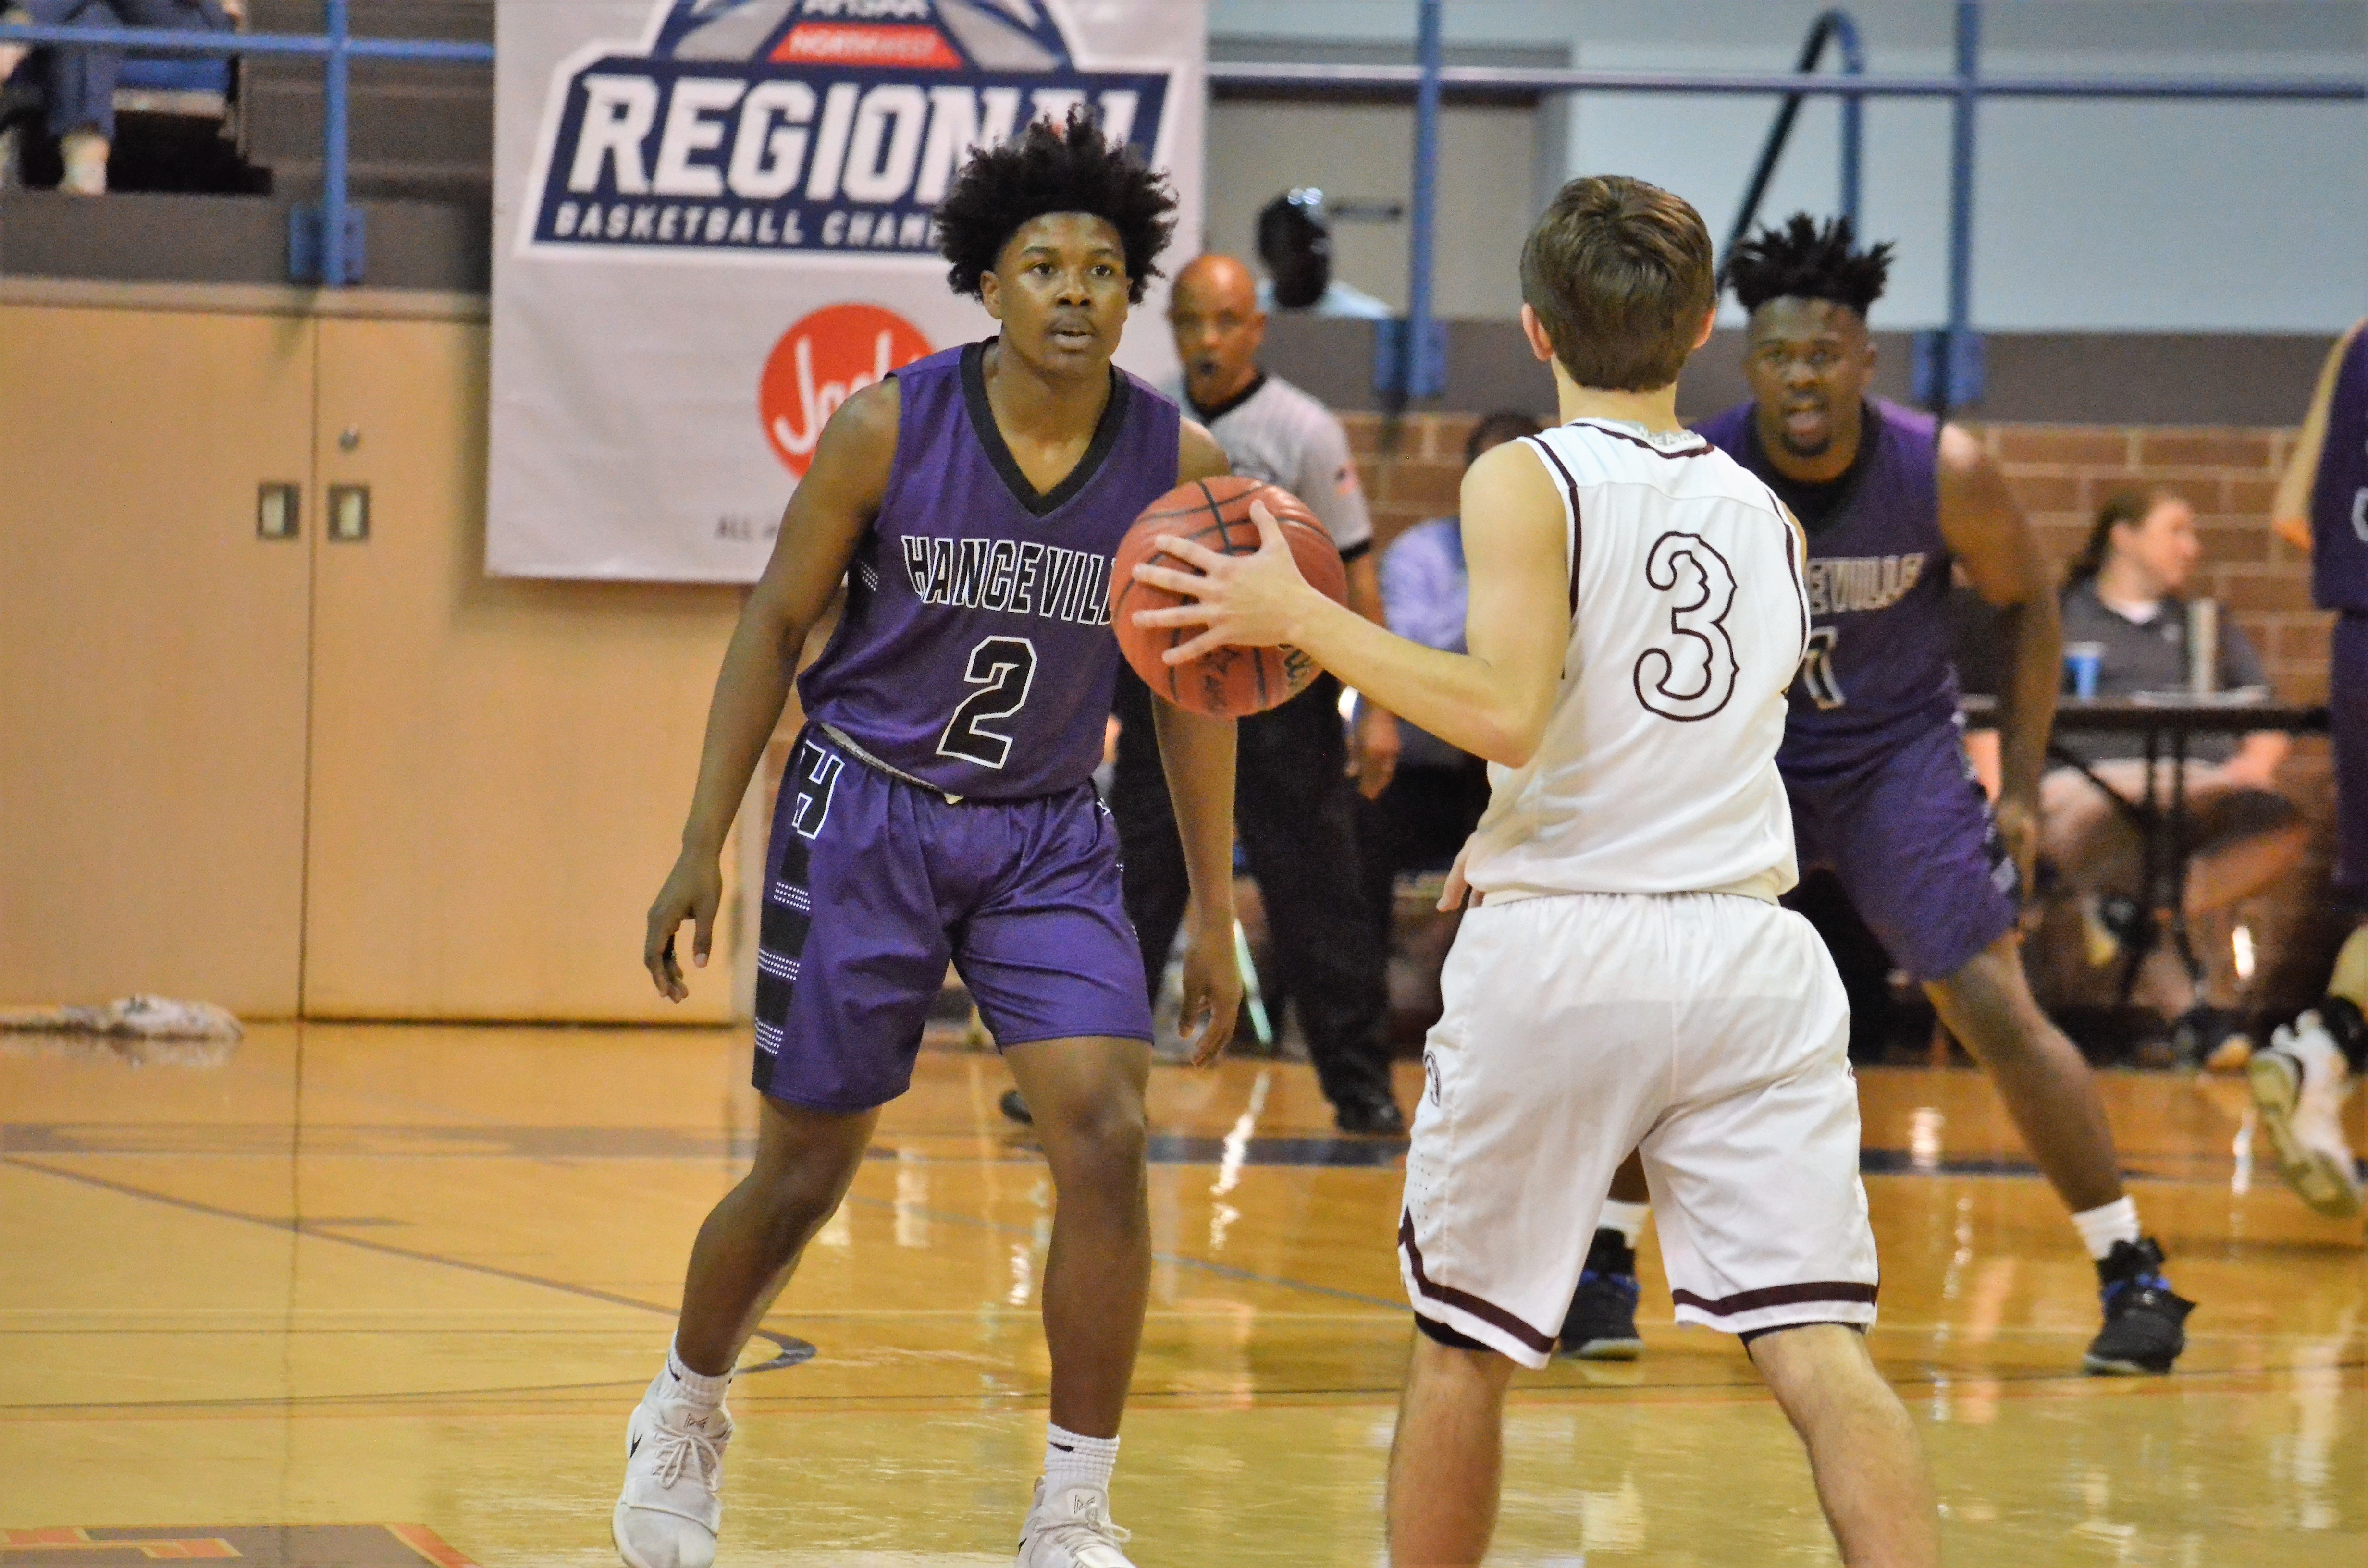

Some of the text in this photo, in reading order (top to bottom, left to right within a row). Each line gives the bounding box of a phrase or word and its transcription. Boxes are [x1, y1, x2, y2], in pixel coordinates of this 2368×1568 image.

[554, 201, 803, 245] BASKETBALL
[1633, 531, 1740, 722] 3
[1805, 552, 1926, 615] EVILLE
[936, 635, 1038, 770] 2
